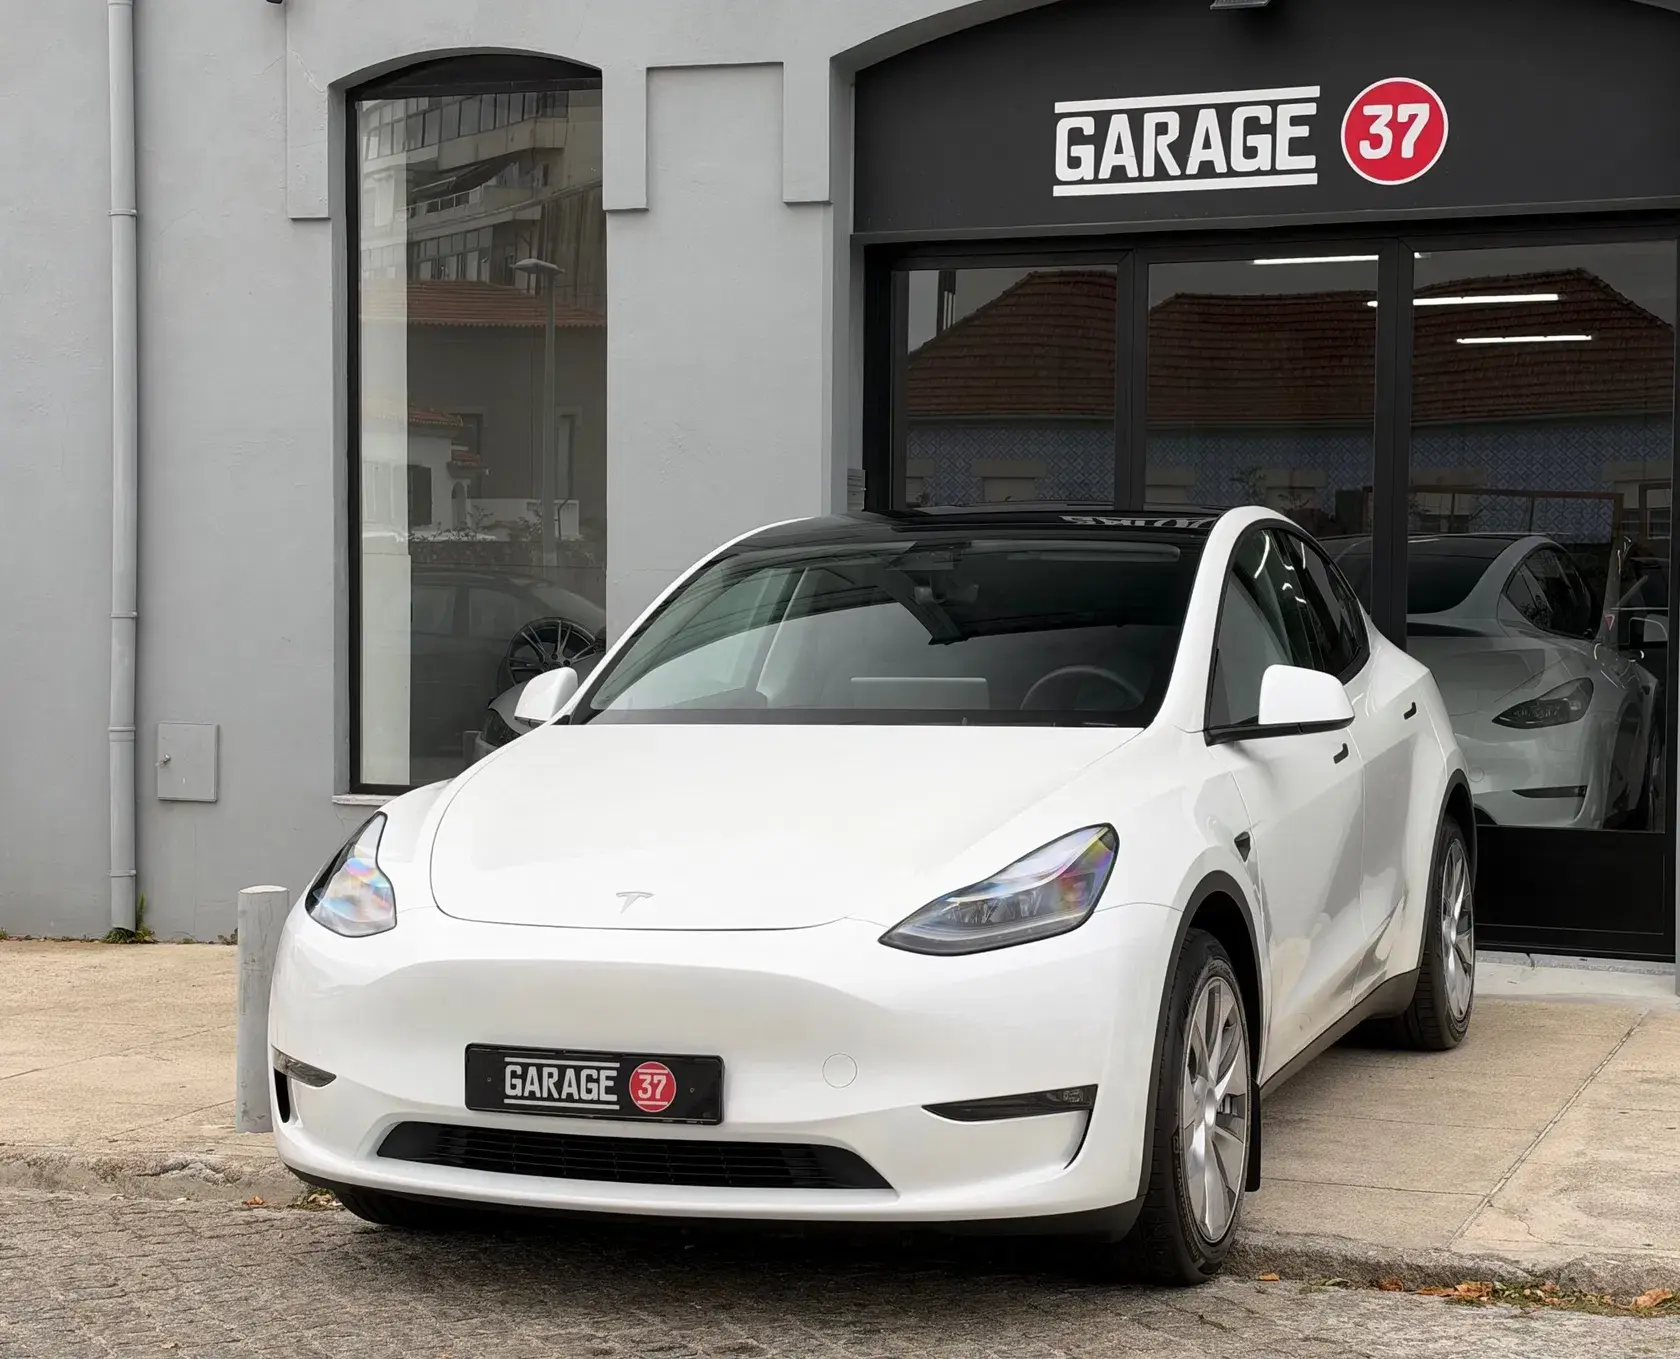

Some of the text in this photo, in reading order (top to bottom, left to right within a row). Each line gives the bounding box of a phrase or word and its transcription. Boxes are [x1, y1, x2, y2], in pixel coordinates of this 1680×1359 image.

[1055, 102, 1430, 181] GARAGE 37
[504, 1064, 668, 1102] GARAGE 37
